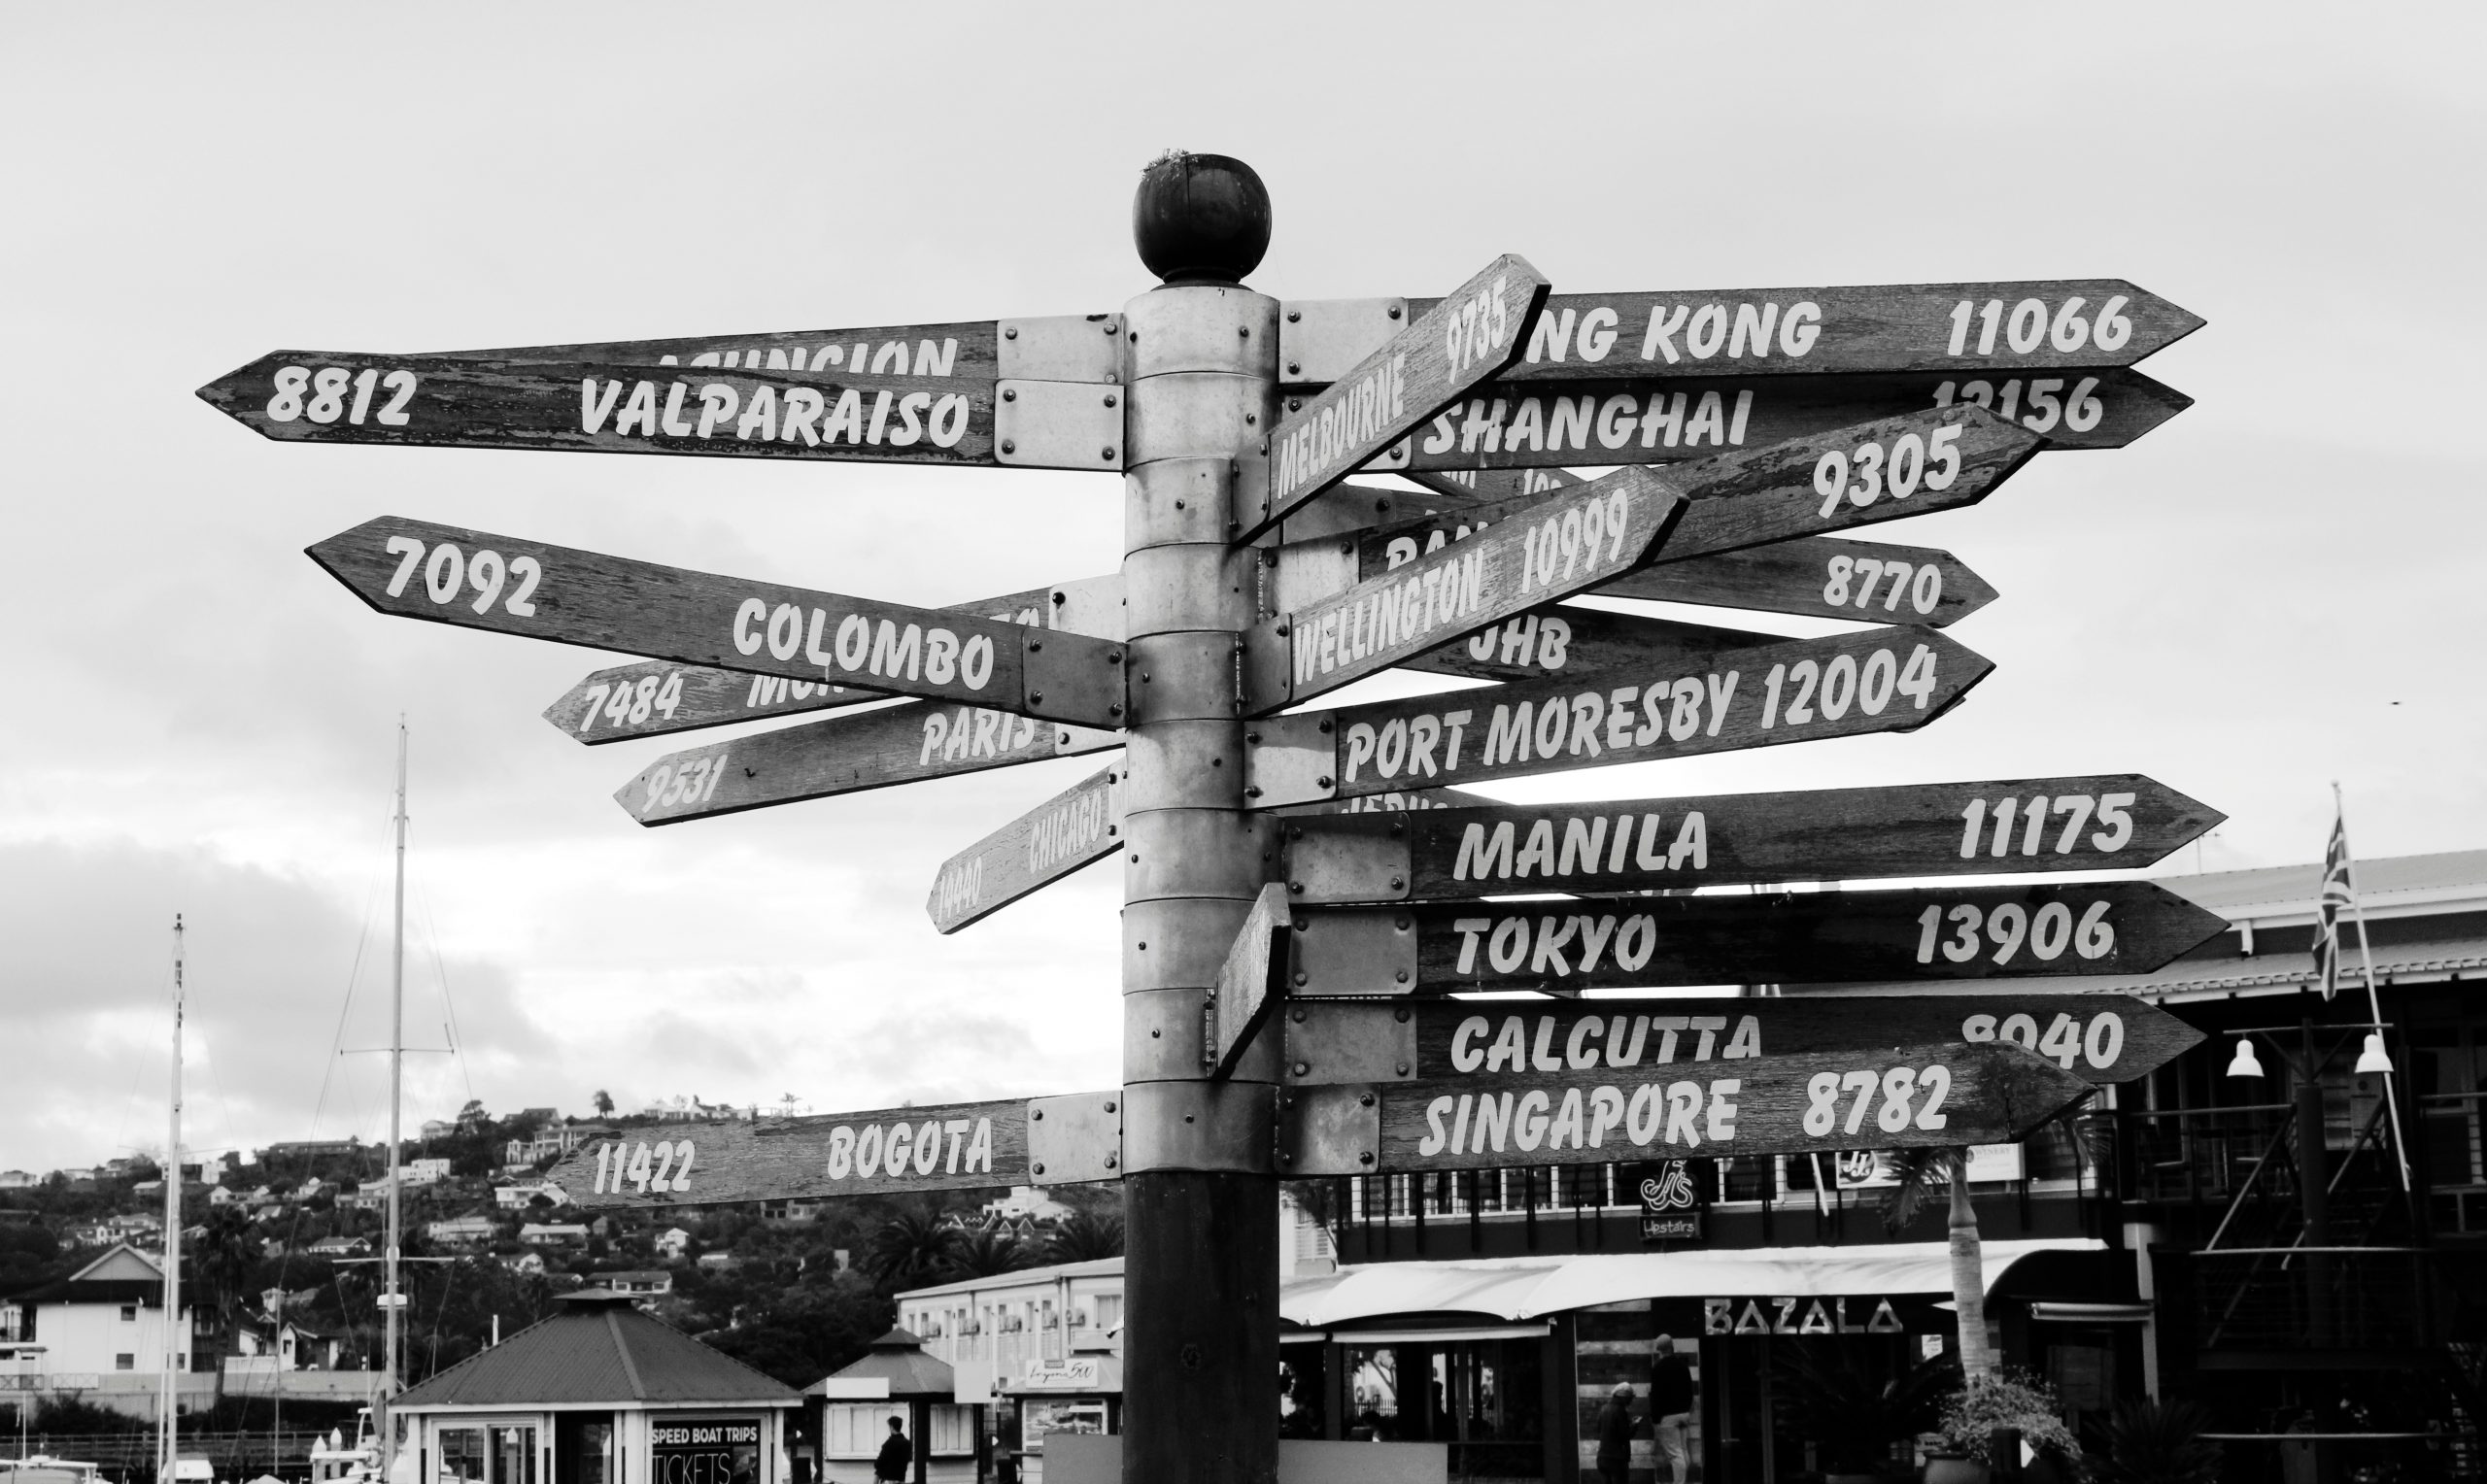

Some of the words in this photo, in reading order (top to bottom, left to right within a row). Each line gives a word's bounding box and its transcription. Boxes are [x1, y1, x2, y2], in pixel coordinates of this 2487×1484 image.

[1525, 307, 1618, 363] NG
[1641, 301, 1822, 365] KONG
[1948, 295, 2132, 356] 11066
[266, 366, 417, 425] 8812
[582, 379, 970, 449] VALPARAISO
[1278, 353, 1406, 499] MELBOURNE
[1447, 275, 1508, 385] 9735
[1423, 390, 1754, 455] SHANGHAI
[1813, 423, 1963, 520] 9305
[386, 535, 542, 617] 7092
[732, 597, 994, 691] COLOMBO
[1295, 547, 1484, 685] WELLINGTON
[1521, 488, 1629, 594] 10999
[1823, 556, 1942, 615] 8770
[580, 672, 683, 732] 7484
[1345, 709, 1473, 783] PORT
[1482, 670, 1740, 765] MORESBY
[1761, 644, 1938, 729] 12004
[642, 755, 729, 813] 9531
[919, 707, 1036, 765] PARIS
[938, 856, 982, 923] 14440
[1030, 788, 1102, 873] CHICAGO
[1453, 811, 1708, 881] MANILA
[1959, 793, 2136, 859] 11175
[1453, 913, 1657, 977] TOKYO
[1917, 900, 2116, 966] 13906
[1450, 1014, 1761, 1073] CALCUTTA
[1419, 1078, 1742, 1157] SINGAPORE
[1803, 1064, 1952, 1136] 8782
[594, 1139, 697, 1195] 11422
[827, 1117, 993, 1180] BOGOTA
[1644, 1219, 1695, 1234] Upstairs
[1704, 1298, 1904, 1335] BAZALA
[652, 1429, 689, 1444] SPEED
[692, 1428, 723, 1443] BOAT
[725, 1426, 758, 1442] TRIPS
[652, 1453, 731, 1484] TICKETS
